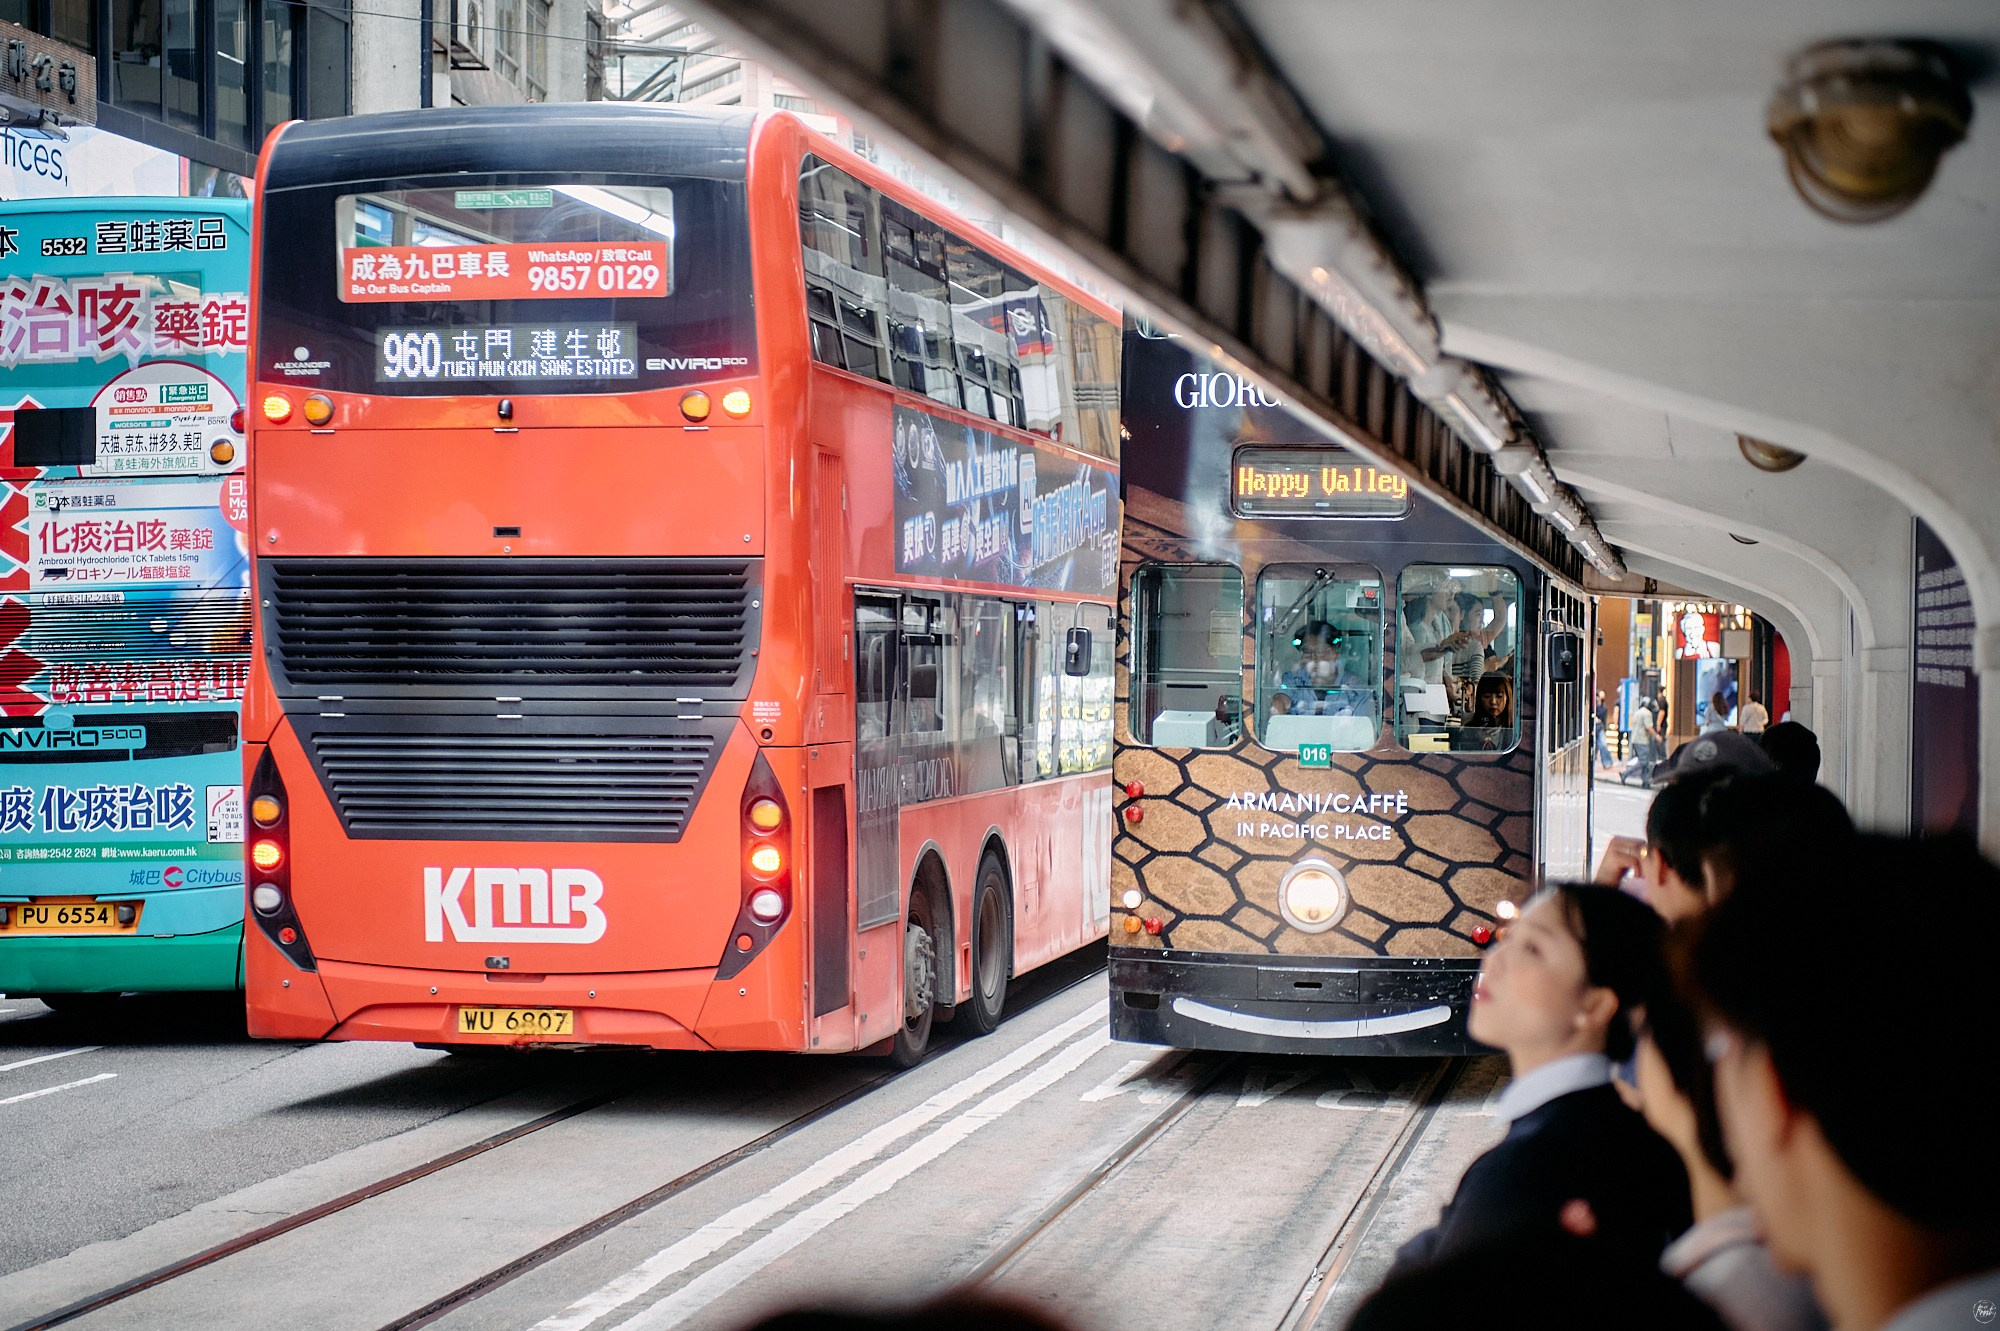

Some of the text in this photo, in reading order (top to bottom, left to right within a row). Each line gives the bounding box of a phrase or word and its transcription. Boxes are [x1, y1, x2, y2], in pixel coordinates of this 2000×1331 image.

[0, 36, 79, 104] 限公司
[41, 238, 88, 256] 5532
[351, 251, 510, 281] 成為九巴車長
[528, 250, 592, 264] WhatsApp
[528, 264, 660, 291] 9857 0129
[352, 282, 451, 294] Be Our Bus Captain
[0, 281, 144, 356] 治咳
[383, 332, 441, 378] 960
[273, 361, 331, 370] ALEXANDER
[284, 368, 321, 376] DENNIS
[442, 358, 636, 377] TUEN MUN (KIN SANG ESTATE)
[169, 385, 207, 396] 緊急出口
[101, 432, 202, 454] 天猫、京东、拼多多、美团
[229, 480, 247, 495] 日
[1239, 467, 1408, 498] Happy Valley
[39, 518, 167, 554] 化痰治咳
[38, 554, 199, 565] Ambroxol Hydrochloride TCK Tablets 15mg
[1302, 748, 1328, 762] 016
[39, 782, 197, 832] 化痰治咳
[1225, 789, 1409, 815] ARMANI/CAFFÈ
[1237, 822, 1393, 841] IN PACIFIC PLACE
[74, 847, 97, 858] 2624
[130, 868, 242, 885] 城巴 Citybus
[424, 867, 607, 944] KMB
[23, 907, 108, 924] PU 6554
[464, 1010, 568, 1032] WU 6807
